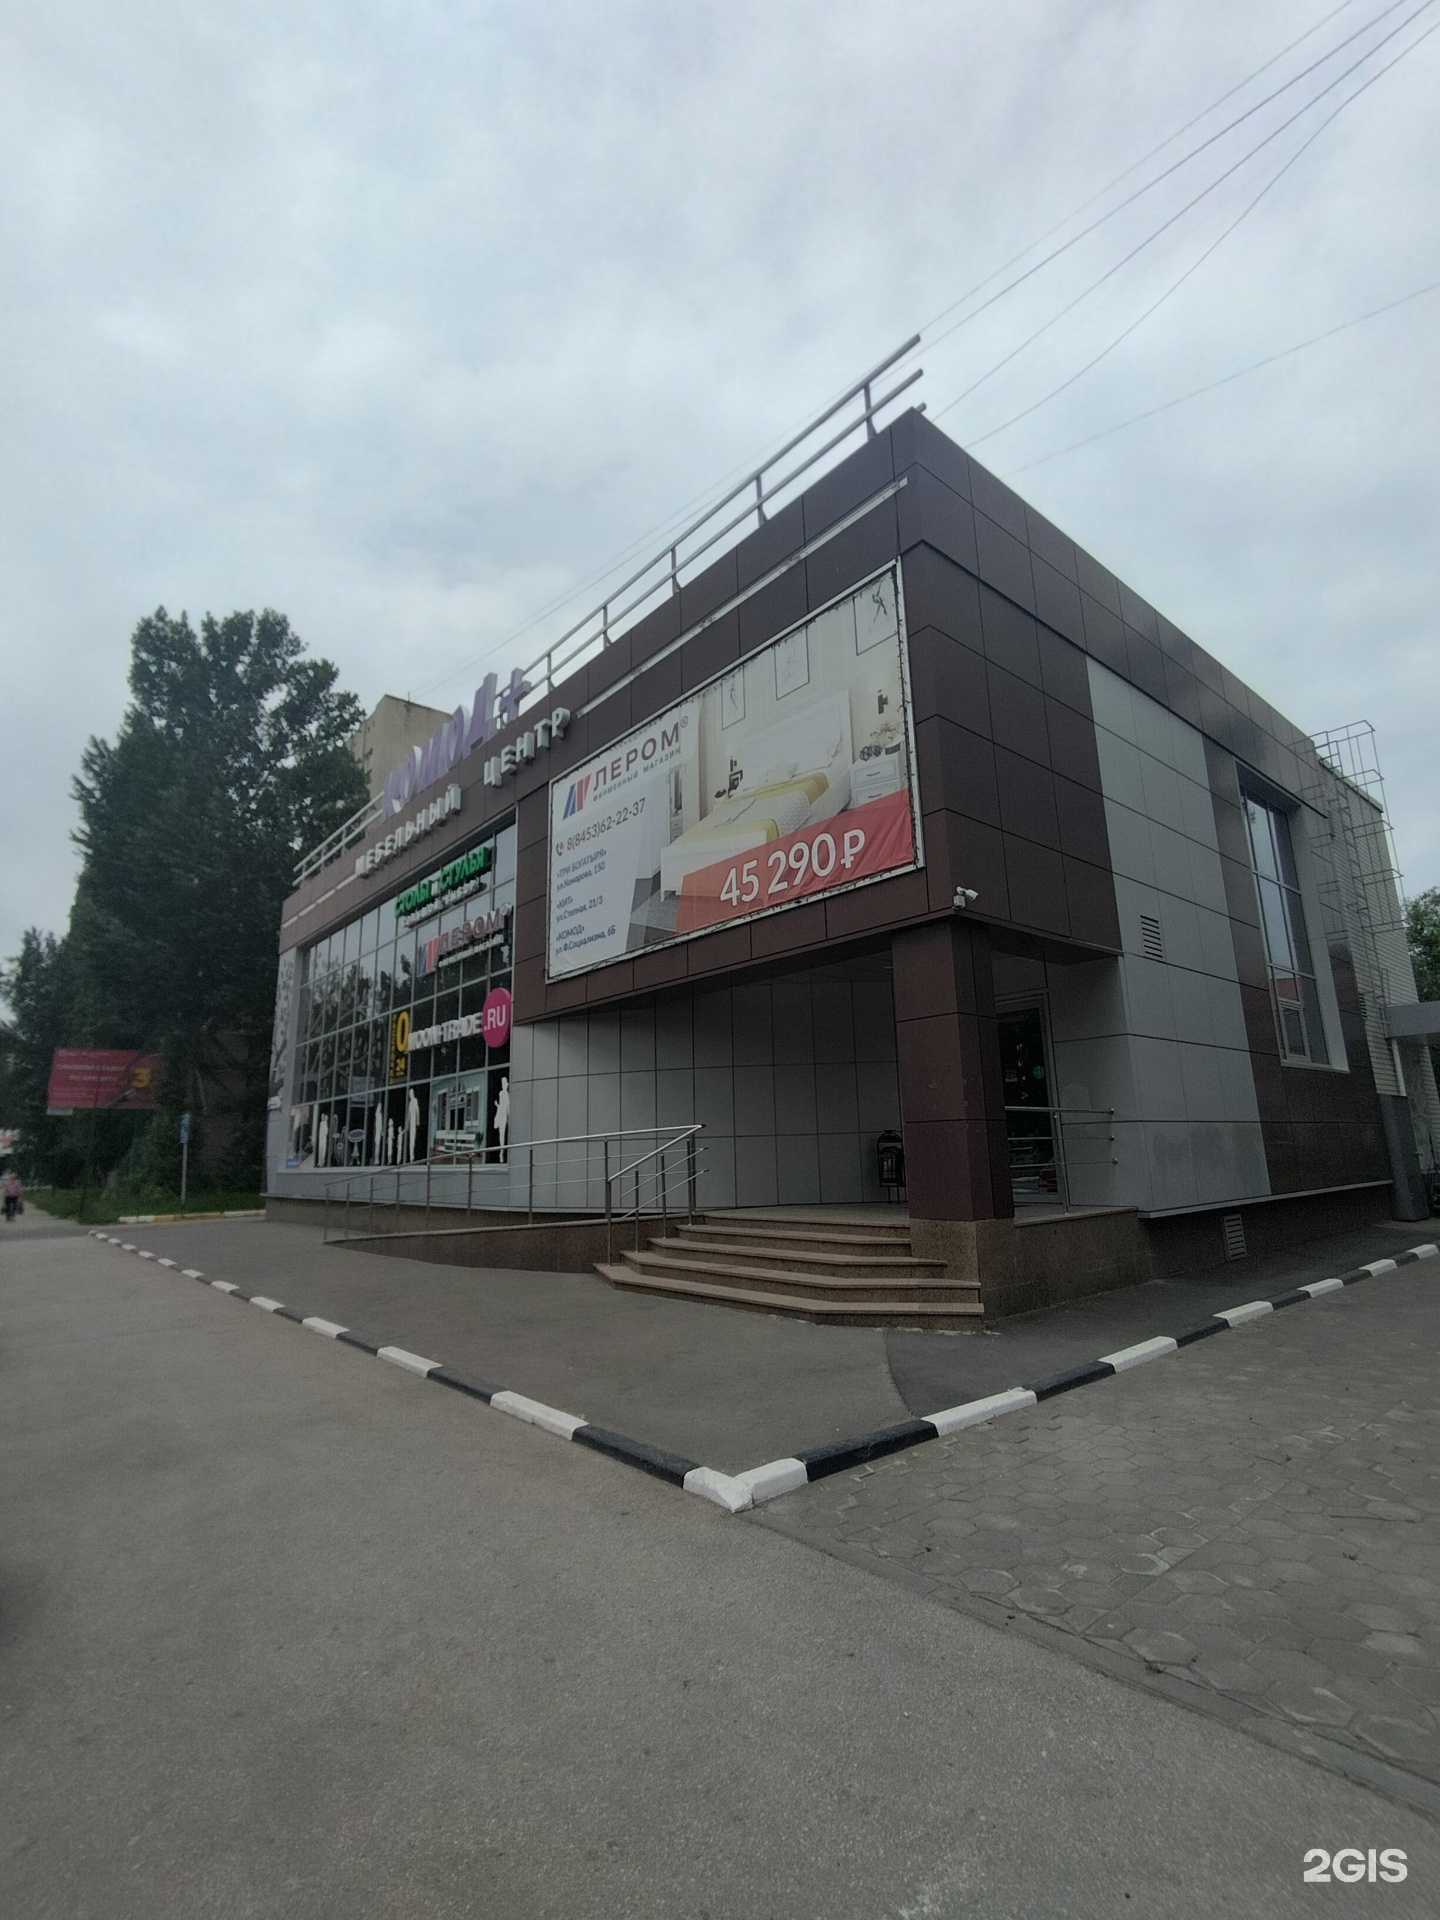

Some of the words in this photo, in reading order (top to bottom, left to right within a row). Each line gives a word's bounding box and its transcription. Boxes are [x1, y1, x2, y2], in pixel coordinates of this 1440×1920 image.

[355, 783, 463, 877] МЕБЕЛЬНЫЙ
[484, 707, 570, 788] ЦЕНТР
[720, 859, 760, 907] 45
